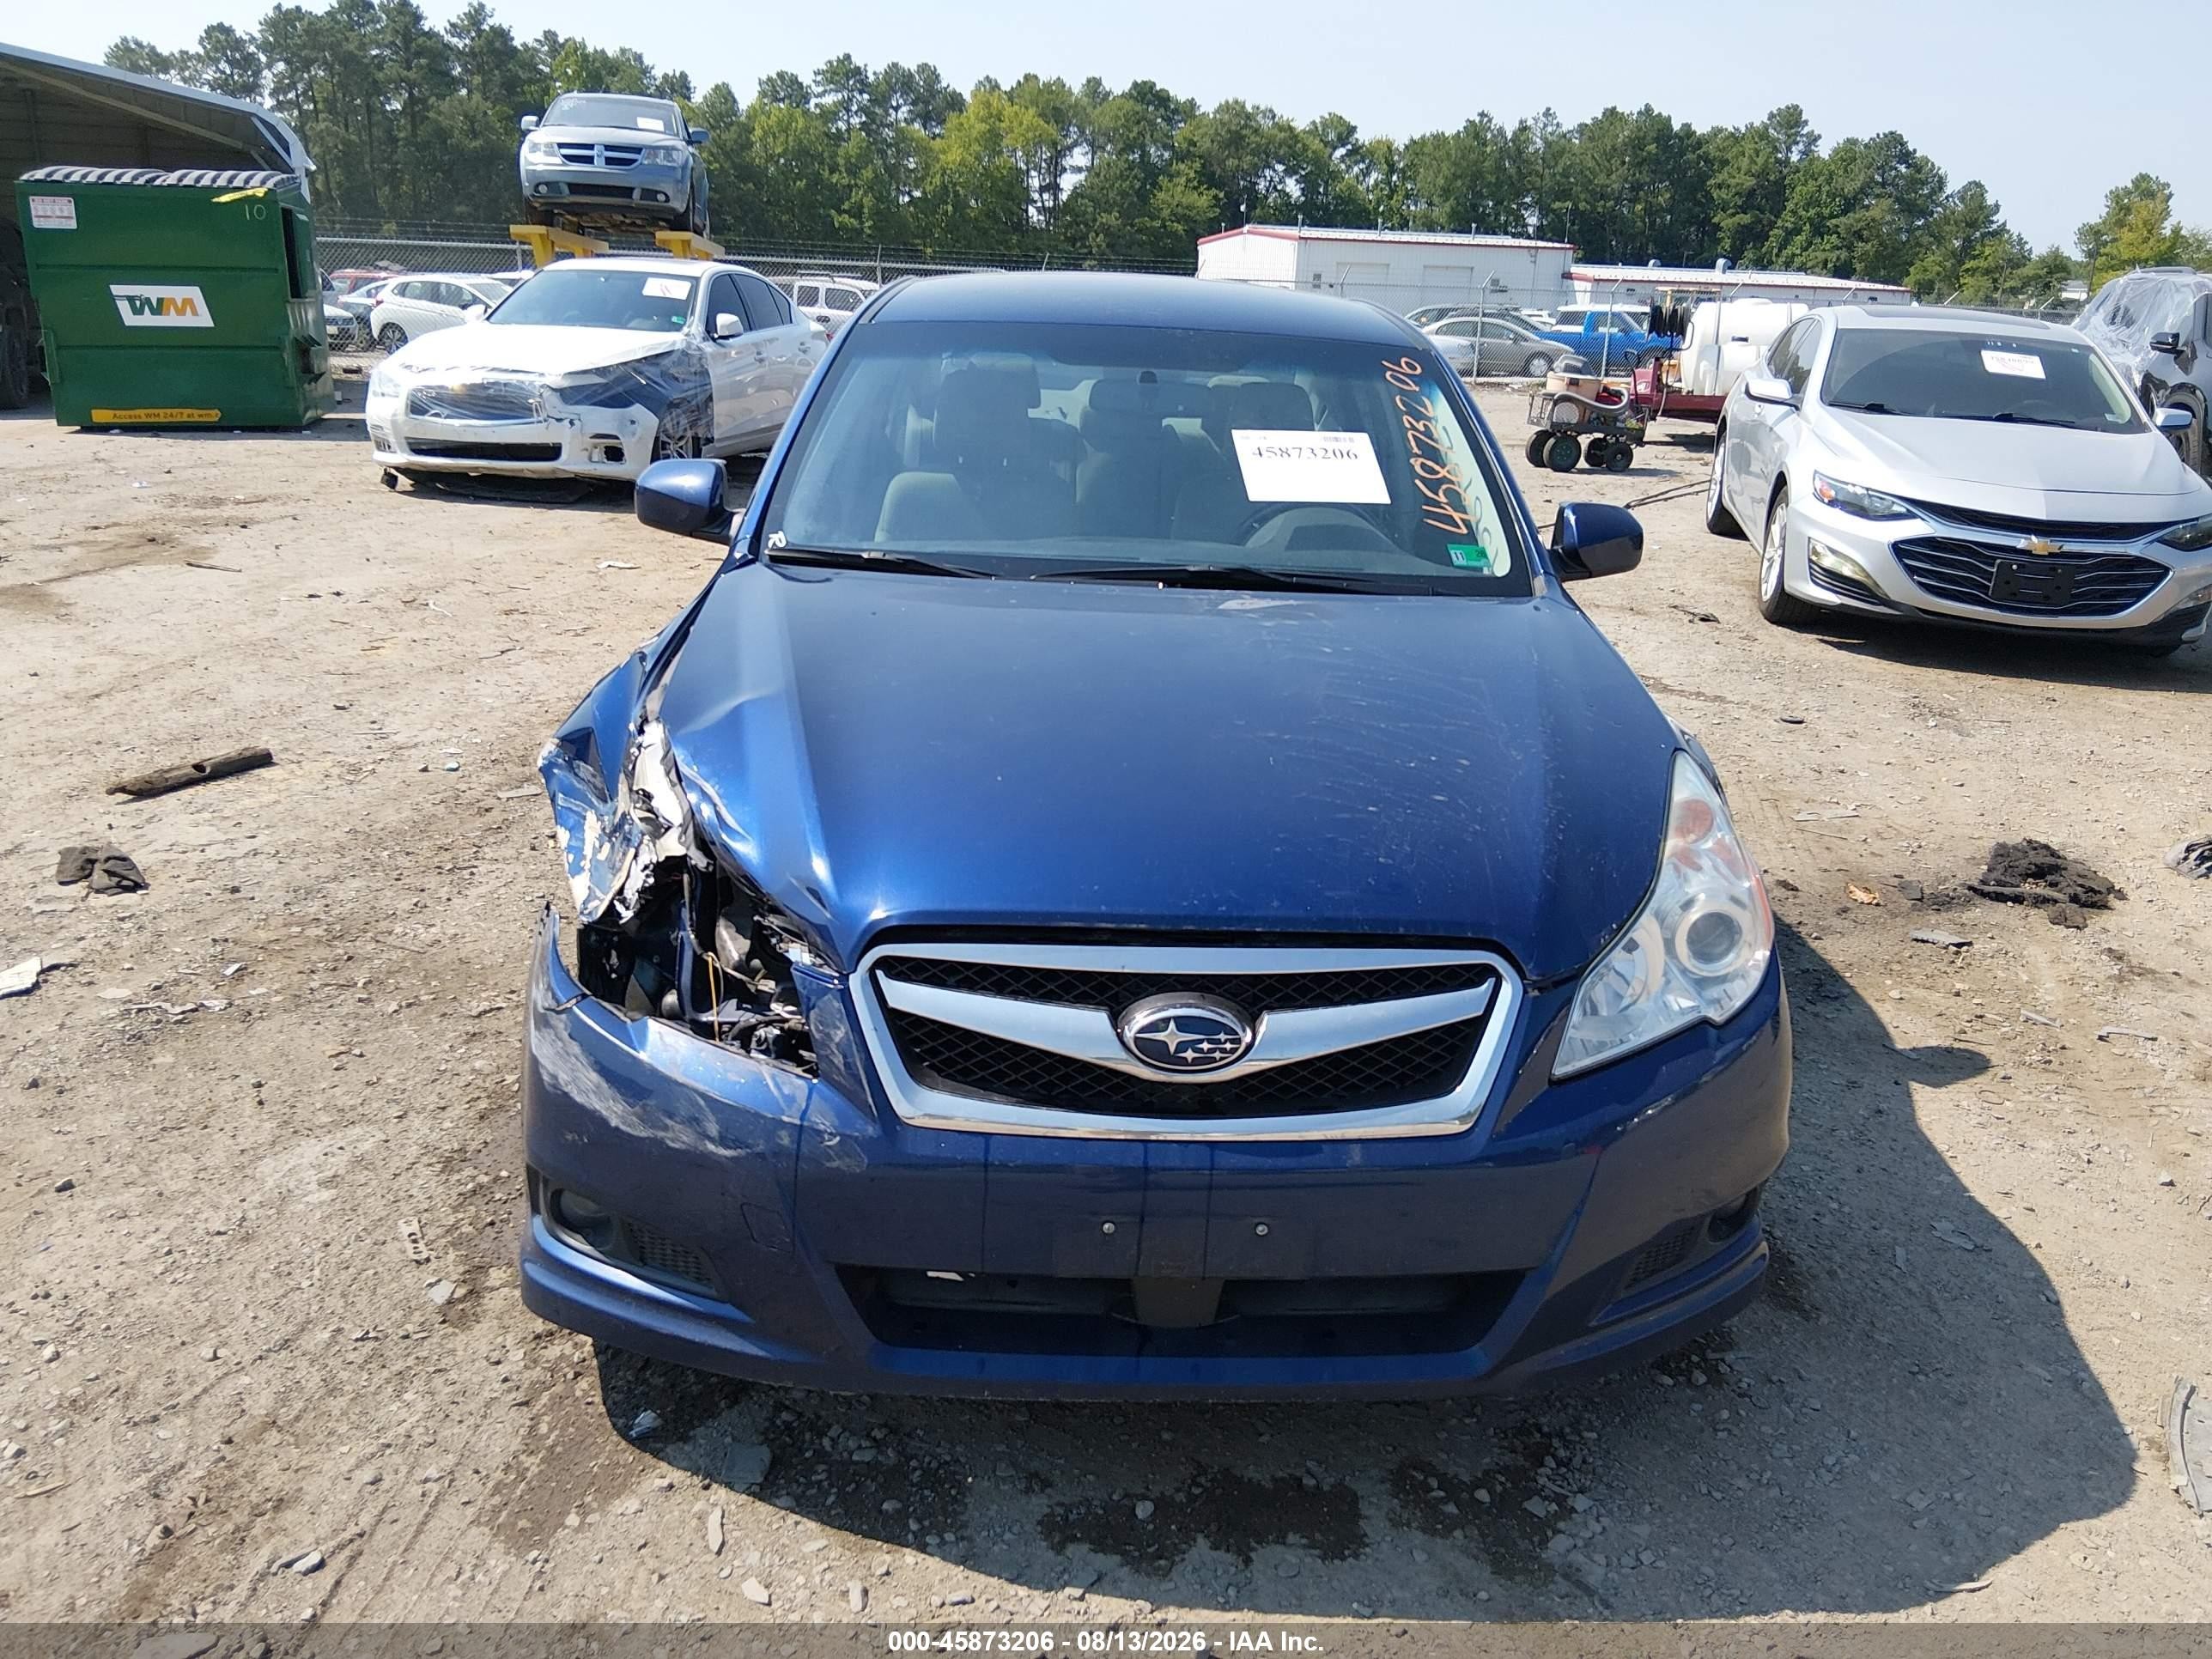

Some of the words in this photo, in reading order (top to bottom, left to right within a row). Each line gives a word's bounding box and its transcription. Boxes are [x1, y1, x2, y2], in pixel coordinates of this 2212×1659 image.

[246, 204, 266, 220] 10
[125, 295, 199, 316] WM
[1252, 446, 1358, 460] 45873206
[1382, 357, 1477, 534] 45873206
[1454, 551, 1465, 561] 11
